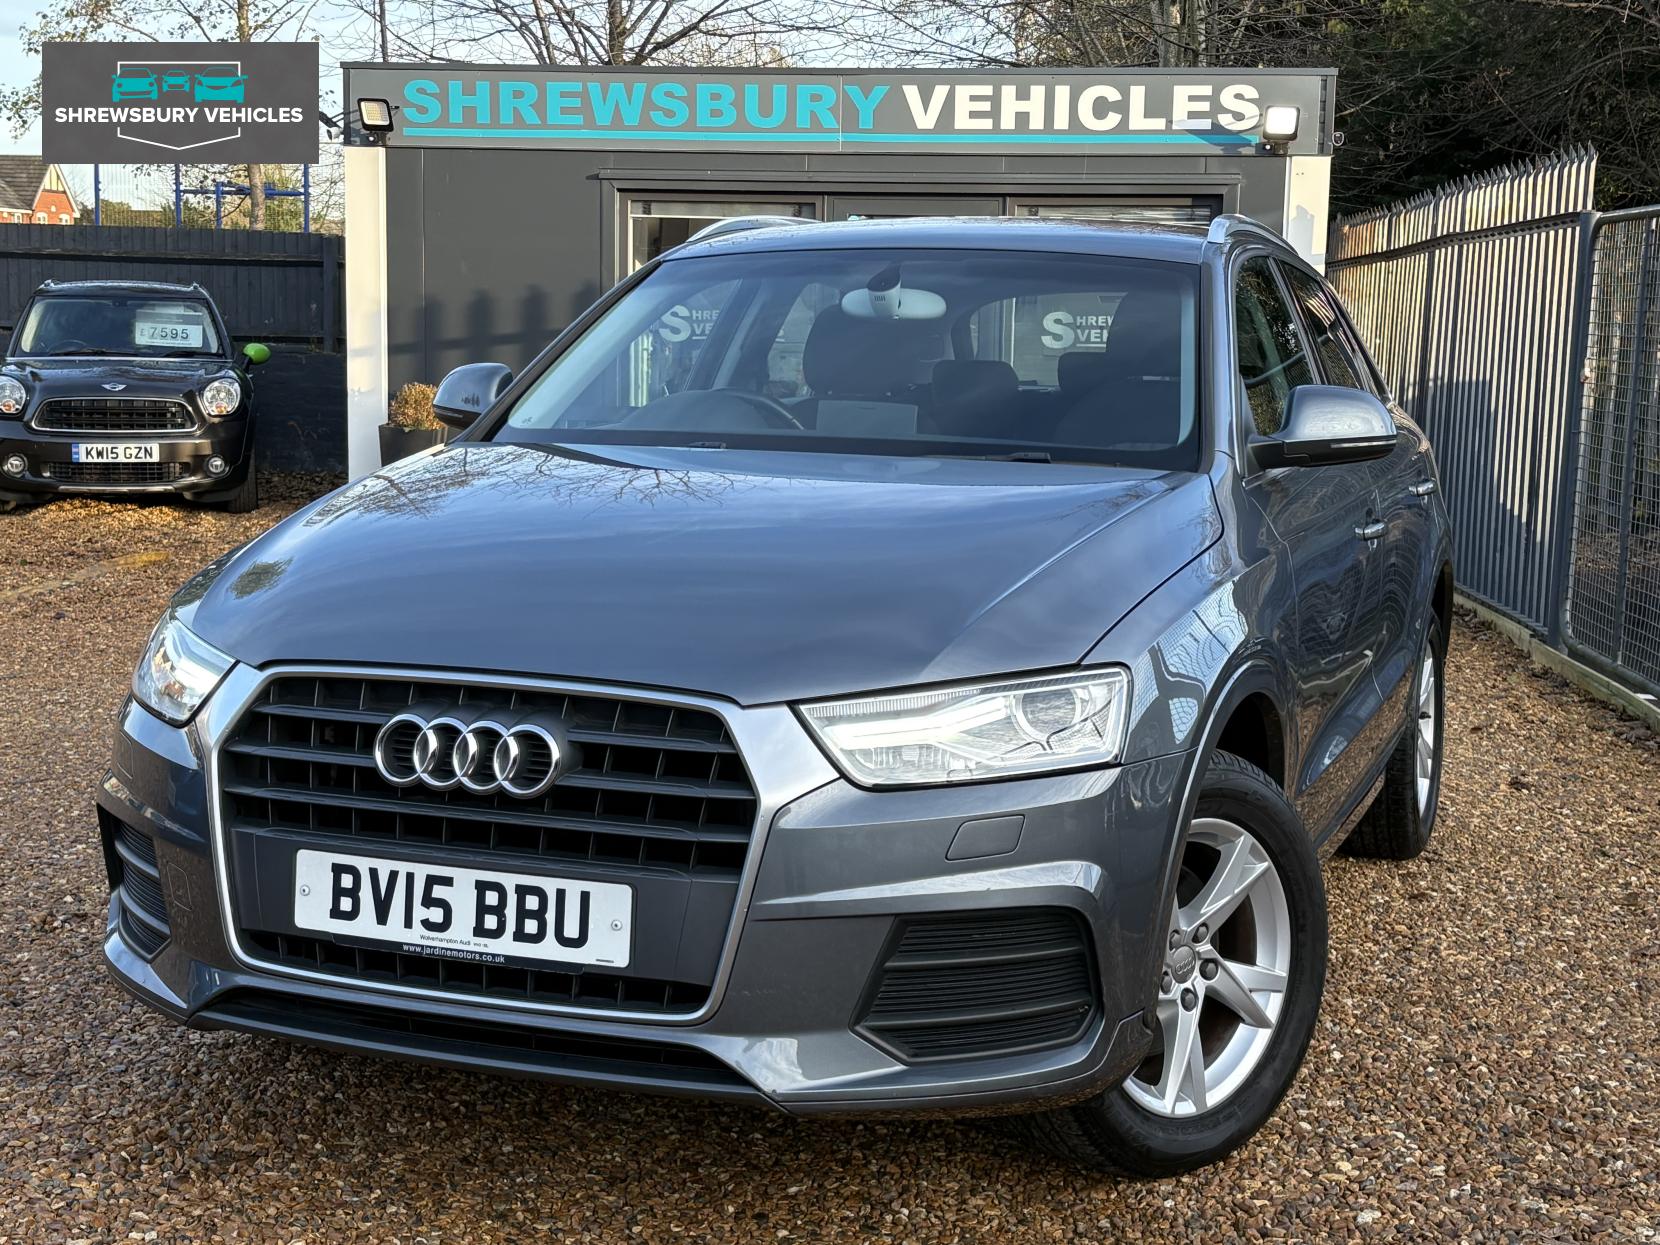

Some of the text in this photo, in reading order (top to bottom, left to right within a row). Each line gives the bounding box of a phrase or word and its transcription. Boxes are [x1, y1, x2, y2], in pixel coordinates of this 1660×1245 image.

[403, 79, 1261, 131] SHREWSBURY VEHICLES
[85, 446, 153, 460] KW15 GZN
[329, 862, 591, 949] BV15 BBU
[420, 934, 459, 945] Wolverhampton
[402, 943, 505, 963] www.jardinemotors.co.uk
